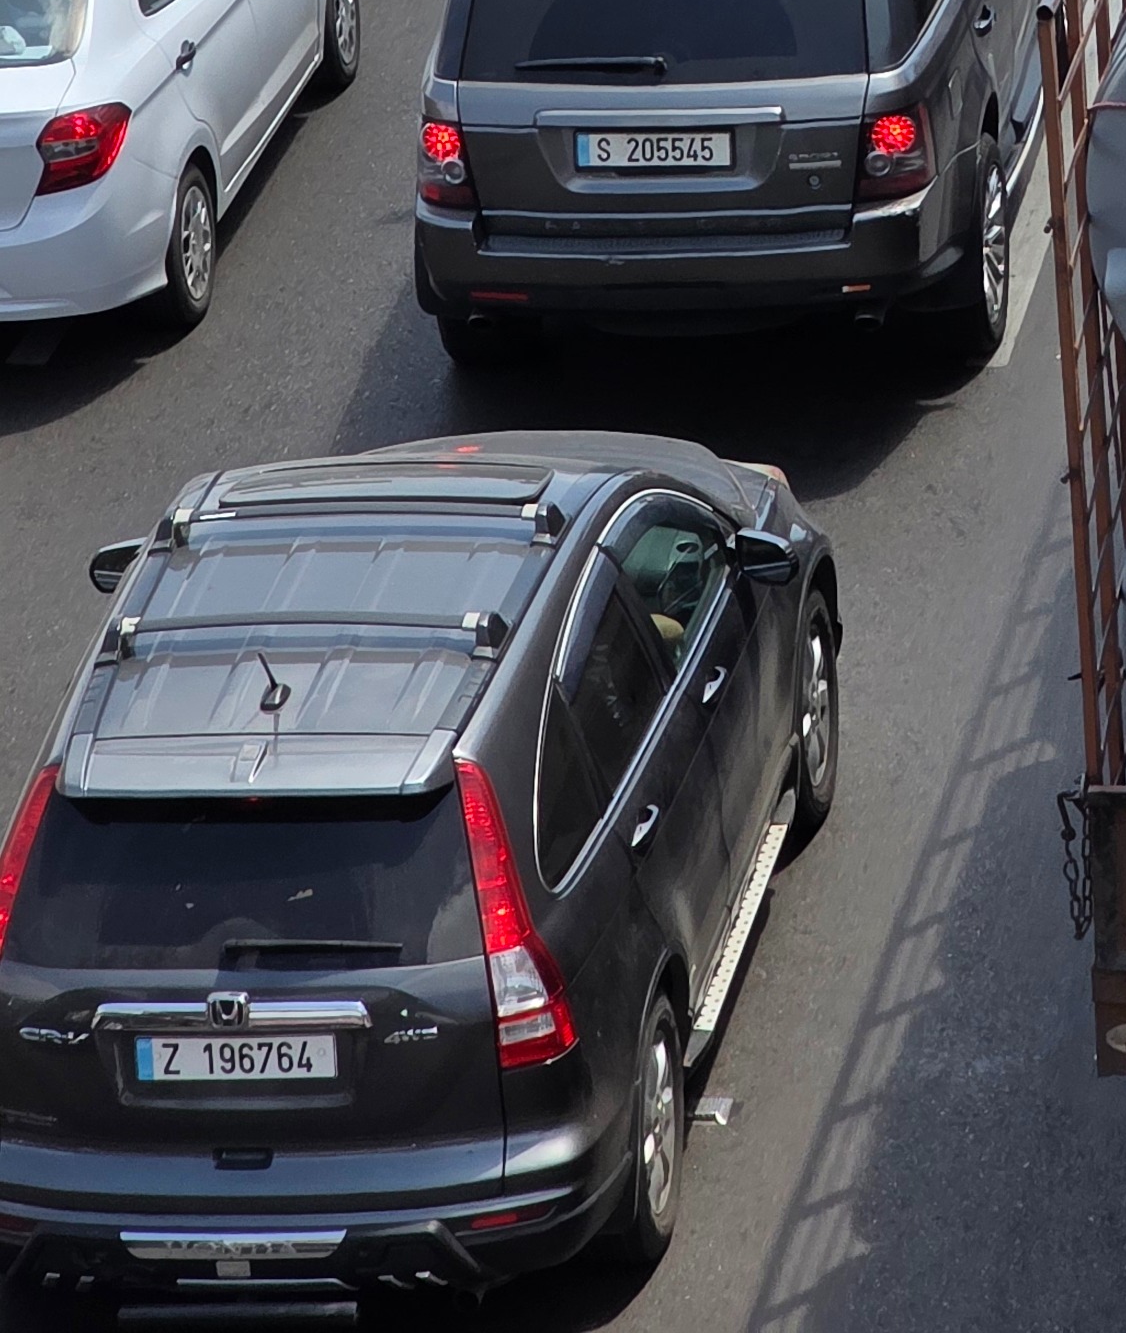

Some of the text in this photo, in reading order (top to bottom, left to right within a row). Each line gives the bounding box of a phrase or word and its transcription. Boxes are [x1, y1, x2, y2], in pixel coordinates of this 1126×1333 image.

[596, 137, 714, 163] S 205545
[163, 1041, 313, 1075] Z 196764
